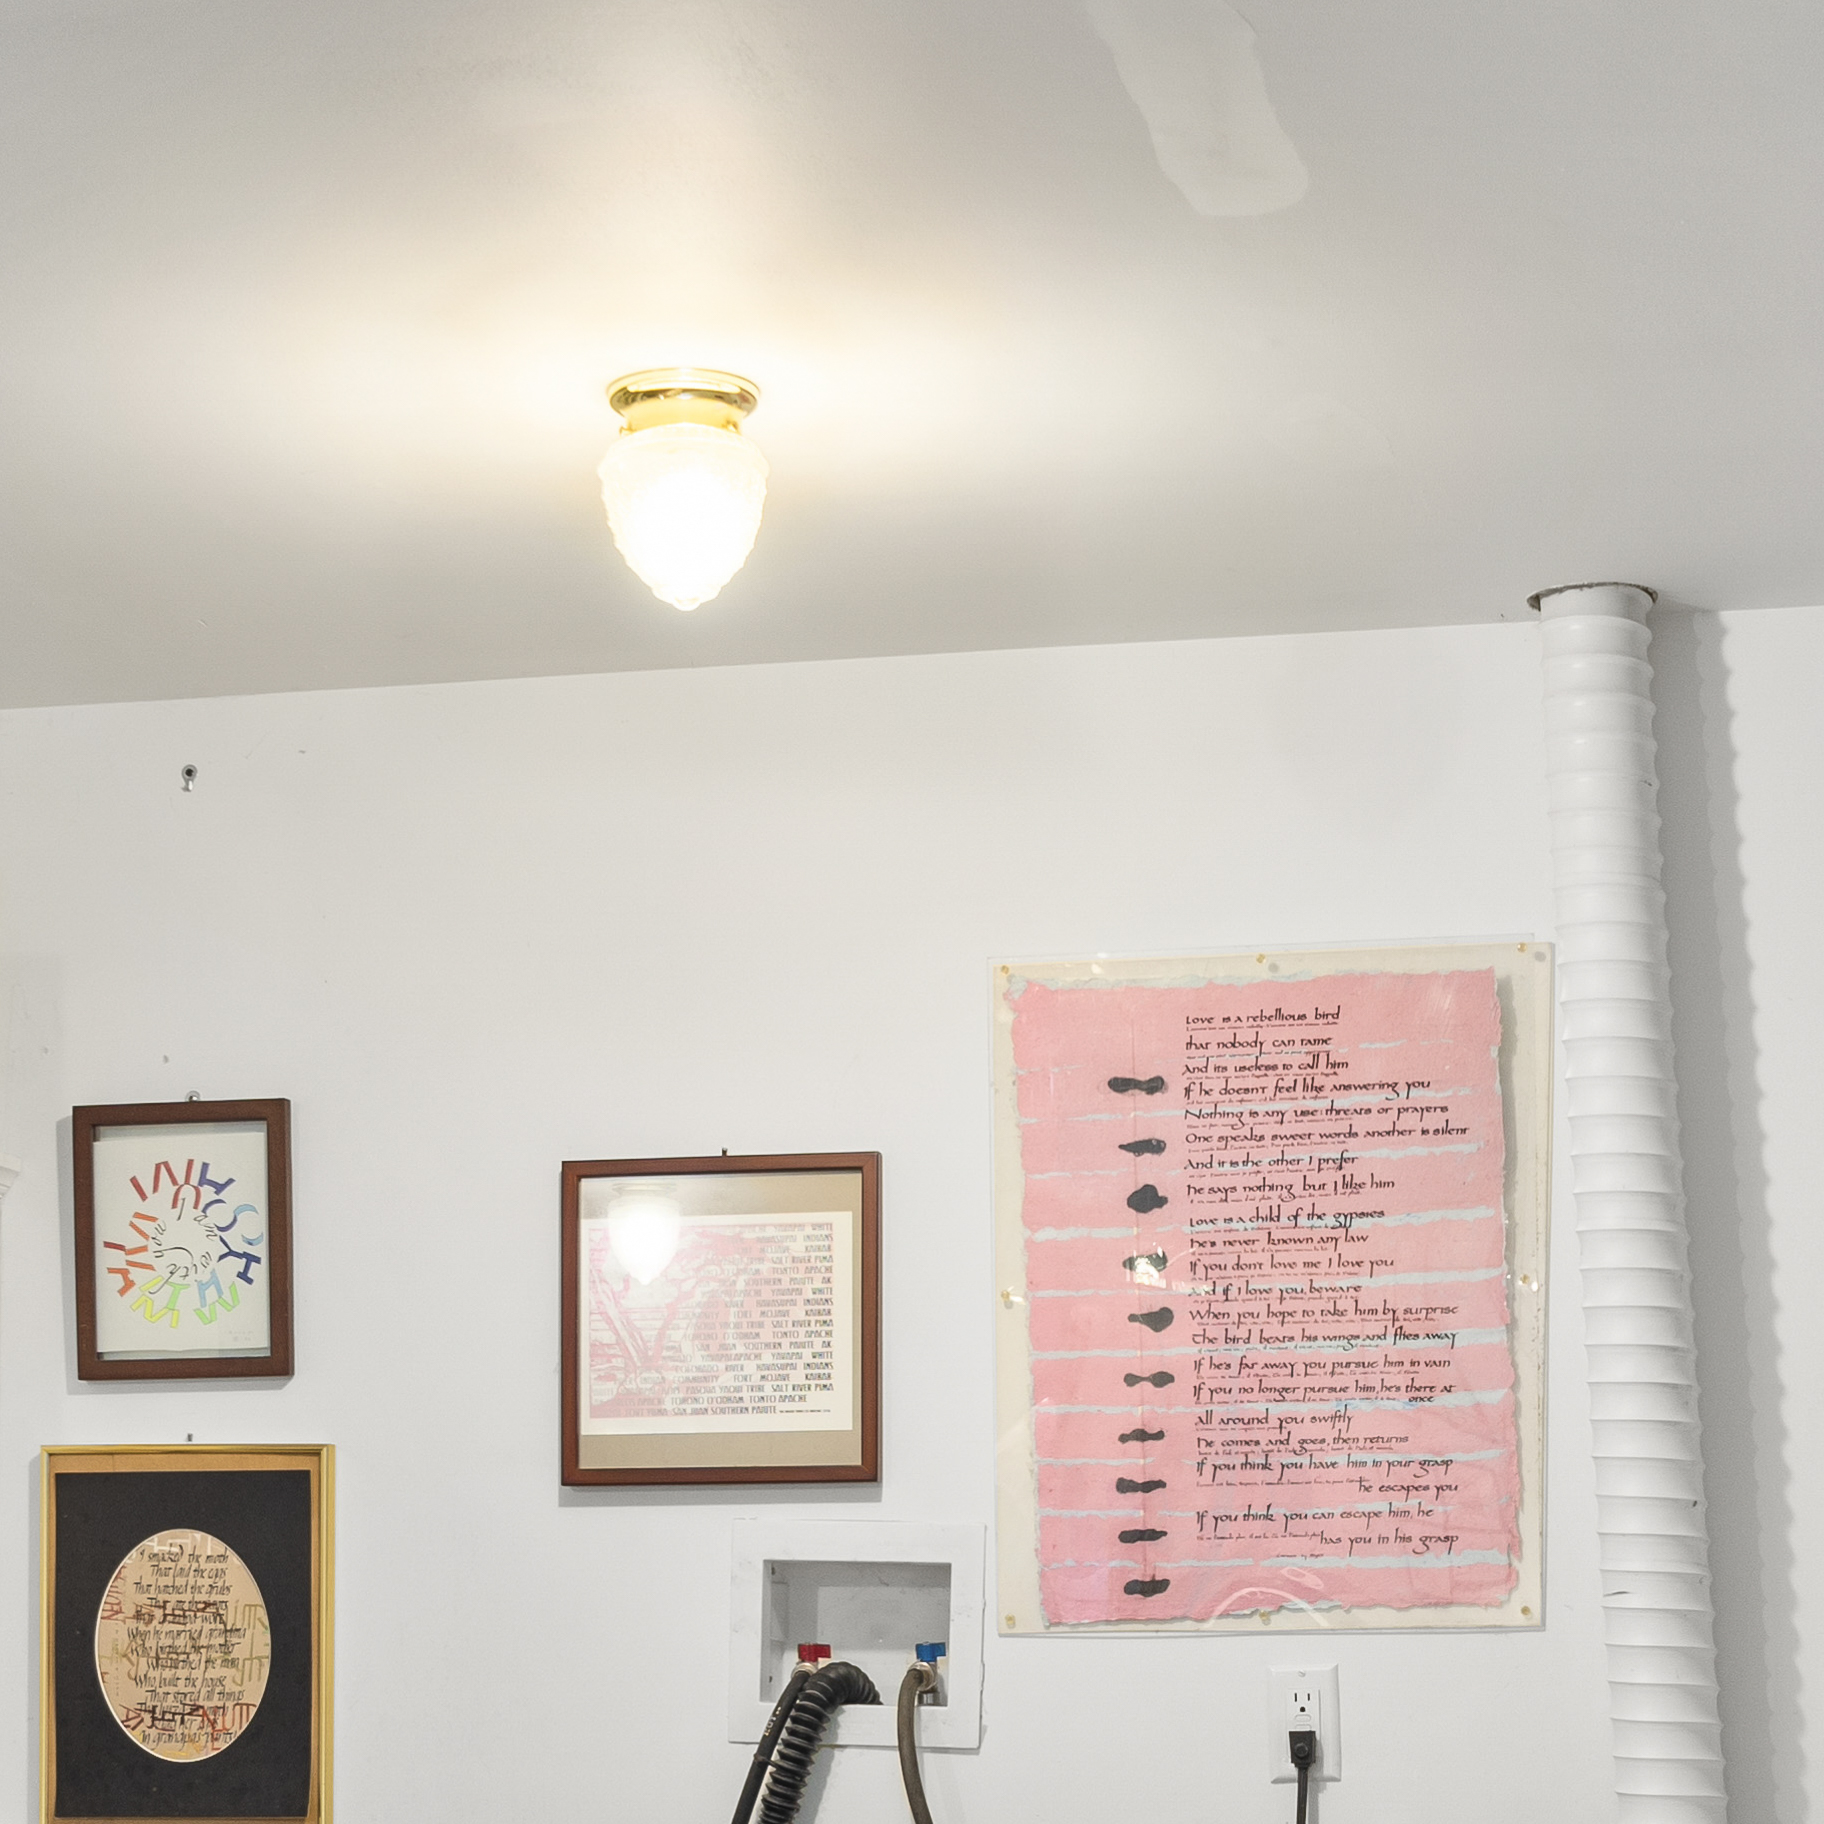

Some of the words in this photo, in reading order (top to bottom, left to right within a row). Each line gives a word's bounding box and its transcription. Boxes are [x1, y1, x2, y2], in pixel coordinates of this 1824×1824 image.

[1186, 1015, 1214, 1024] Love
[1247, 1008, 1308, 1024] rebellious
[1315, 1005, 1340, 1021] bird
[1217, 1031, 1266, 1057] nobody
[1272, 1039, 1295, 1047] can
[1182, 1056, 1209, 1075] And
[1233, 1055, 1278, 1073] useless
[1298, 1052, 1320, 1070] call
[1326, 1053, 1348, 1069] him
[1184, 1082, 1195, 1100] If
[1274, 1076, 1298, 1099] feel
[1303, 1076, 1325, 1094] like
[1330, 1081, 1399, 1101] answering
[1406, 1081, 1430, 1099] you
[1185, 1103, 1244, 1130] Nothing
[1262, 1109, 1286, 1125] any
[1397, 1105, 1449, 1123] prayers
[1186, 1134, 1212, 1143] One
[1217, 1130, 1265, 1150] speaks
[1319, 1124, 1358, 1141] words
[1364, 1127, 1415, 1137] another
[1433, 1119, 1469, 1136] silent
[1184, 1154, 1213, 1169] And
[1242, 1152, 1261, 1166] the
[1269, 1150, 1303, 1166] other
[1318, 1149, 1358, 1175] prefer
[1208, 1186, 1238, 1203] says
[1243, 1177, 1295, 1202] nothing
[1303, 1175, 1326, 1191] but
[1342, 1174, 1366, 1191] like
[1371, 1173, 1394, 1188] him
[194, 1213, 219, 1240] am
[1190, 1215, 1218, 1227] Love
[1249, 1204, 1280, 1223] child
[1287, 1207, 1304, 1228] of
[1307, 1203, 1326, 1220] the
[1332, 1209, 1384, 1231] gypsies
[1223, 1238, 1259, 1246] never
[1268, 1231, 1313, 1245] known
[1316, 1236, 1340, 1251] any
[1343, 1227, 1368, 1242] law
[1190, 1259, 1201, 1275] If
[1203, 1262, 1227, 1282] you
[1271, 1254, 1296, 1269] love
[1338, 1253, 1364, 1267] love
[1370, 1259, 1393, 1278] you
[1219, 1408, 1268, 1425] around
[1276, 1416, 1304, 1435] you
[1311, 1404, 1353, 1434] swiftly
[1379, 1484, 1429, 1503] escapes
[1435, 1485, 1458, 1501] you
[1319, 1531, 1341, 1544] has
[1349, 1535, 1371, 1557] you
[1378, 1535, 1389, 1544] in
[1395, 1528, 1412, 1543] his
[1414, 1535, 1458, 1554] grasp
